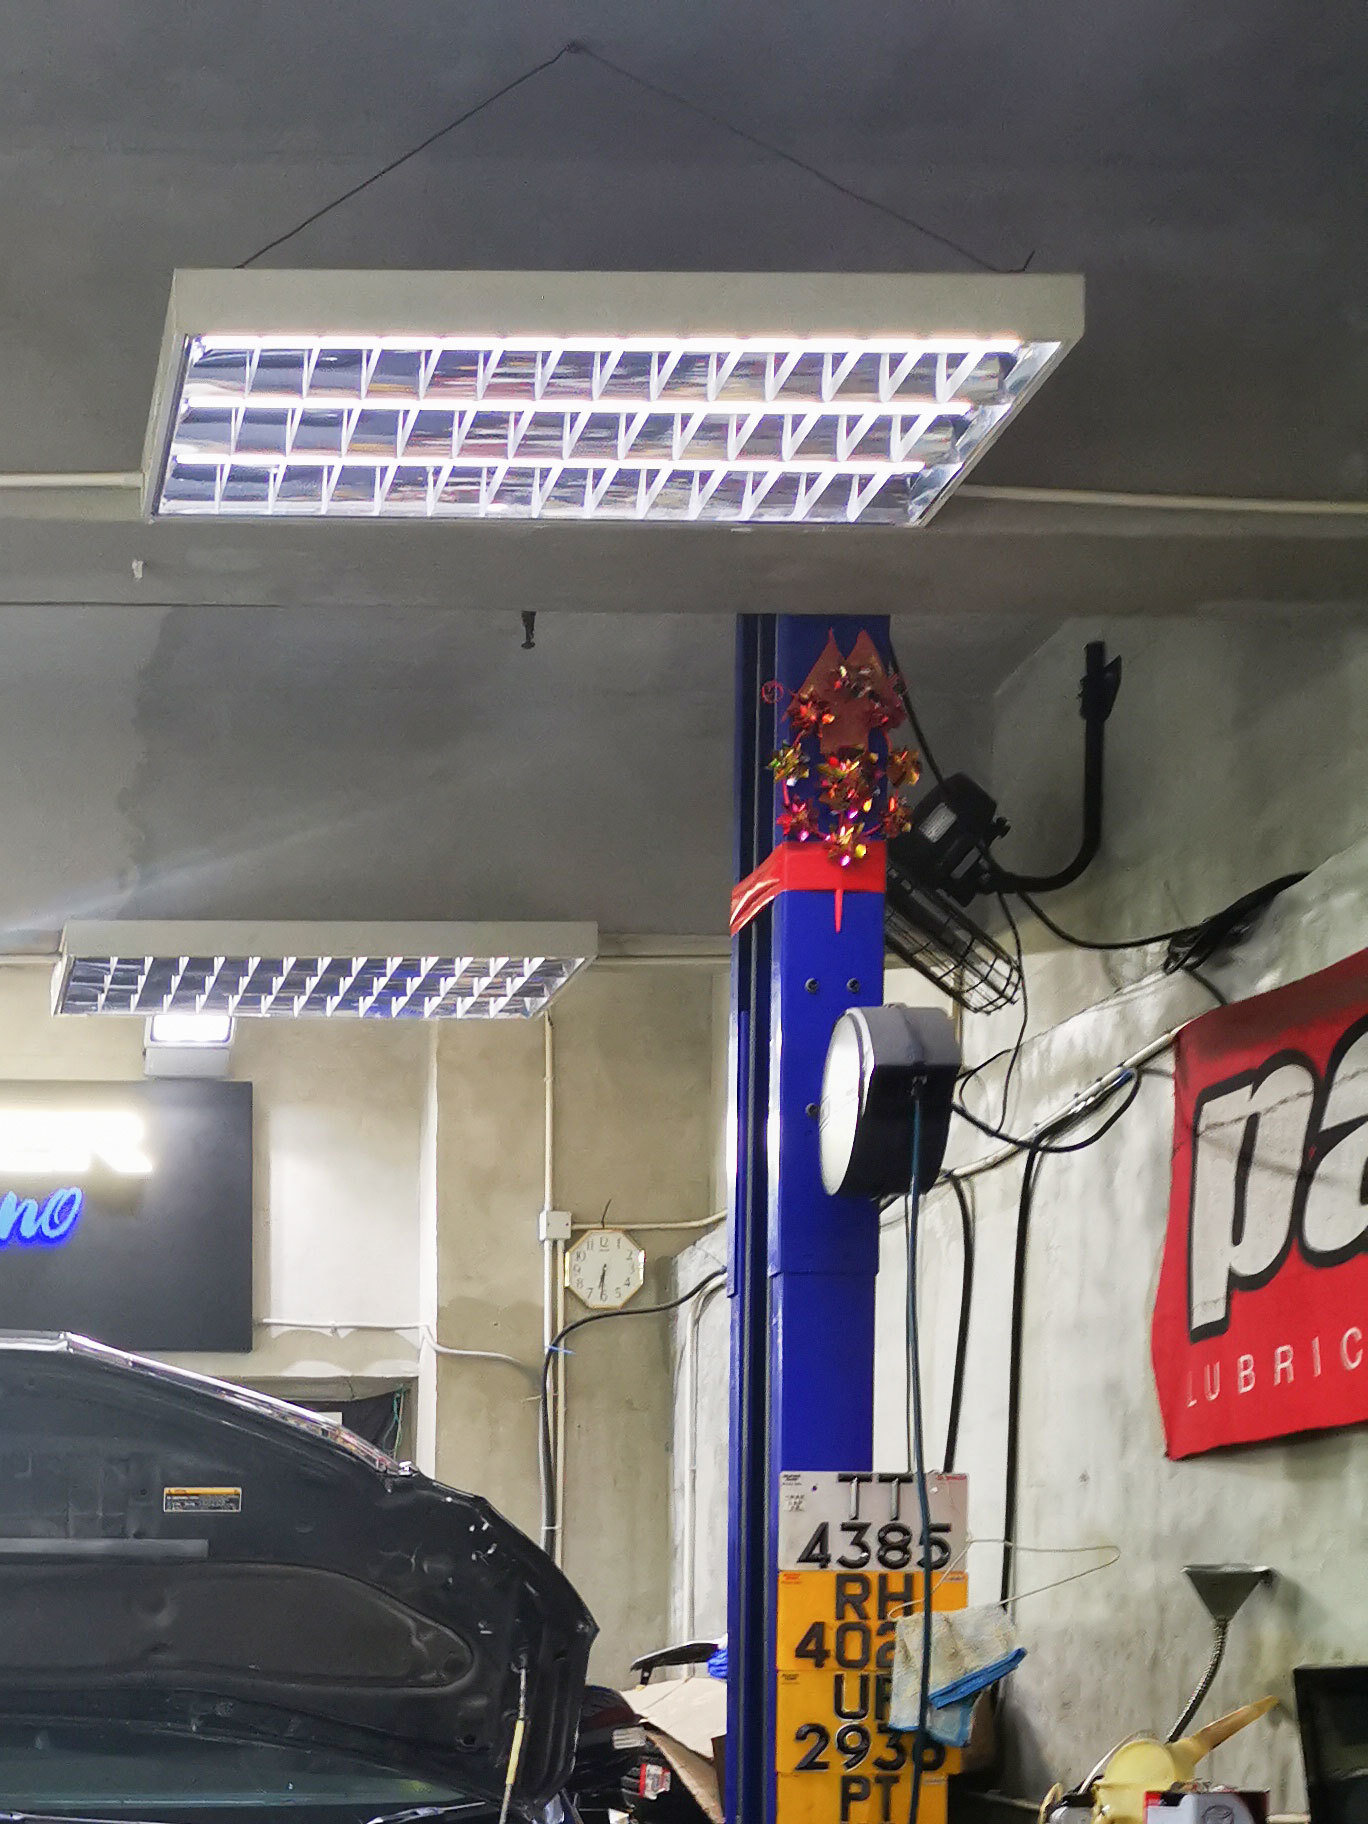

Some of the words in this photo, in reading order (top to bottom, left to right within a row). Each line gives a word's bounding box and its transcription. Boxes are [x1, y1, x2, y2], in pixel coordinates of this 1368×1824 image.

[838, 1473, 913, 1521] TT
[797, 1521, 952, 1570] 4385
[835, 1573, 914, 1620] RH
[841, 1775, 900, 1822] PT
